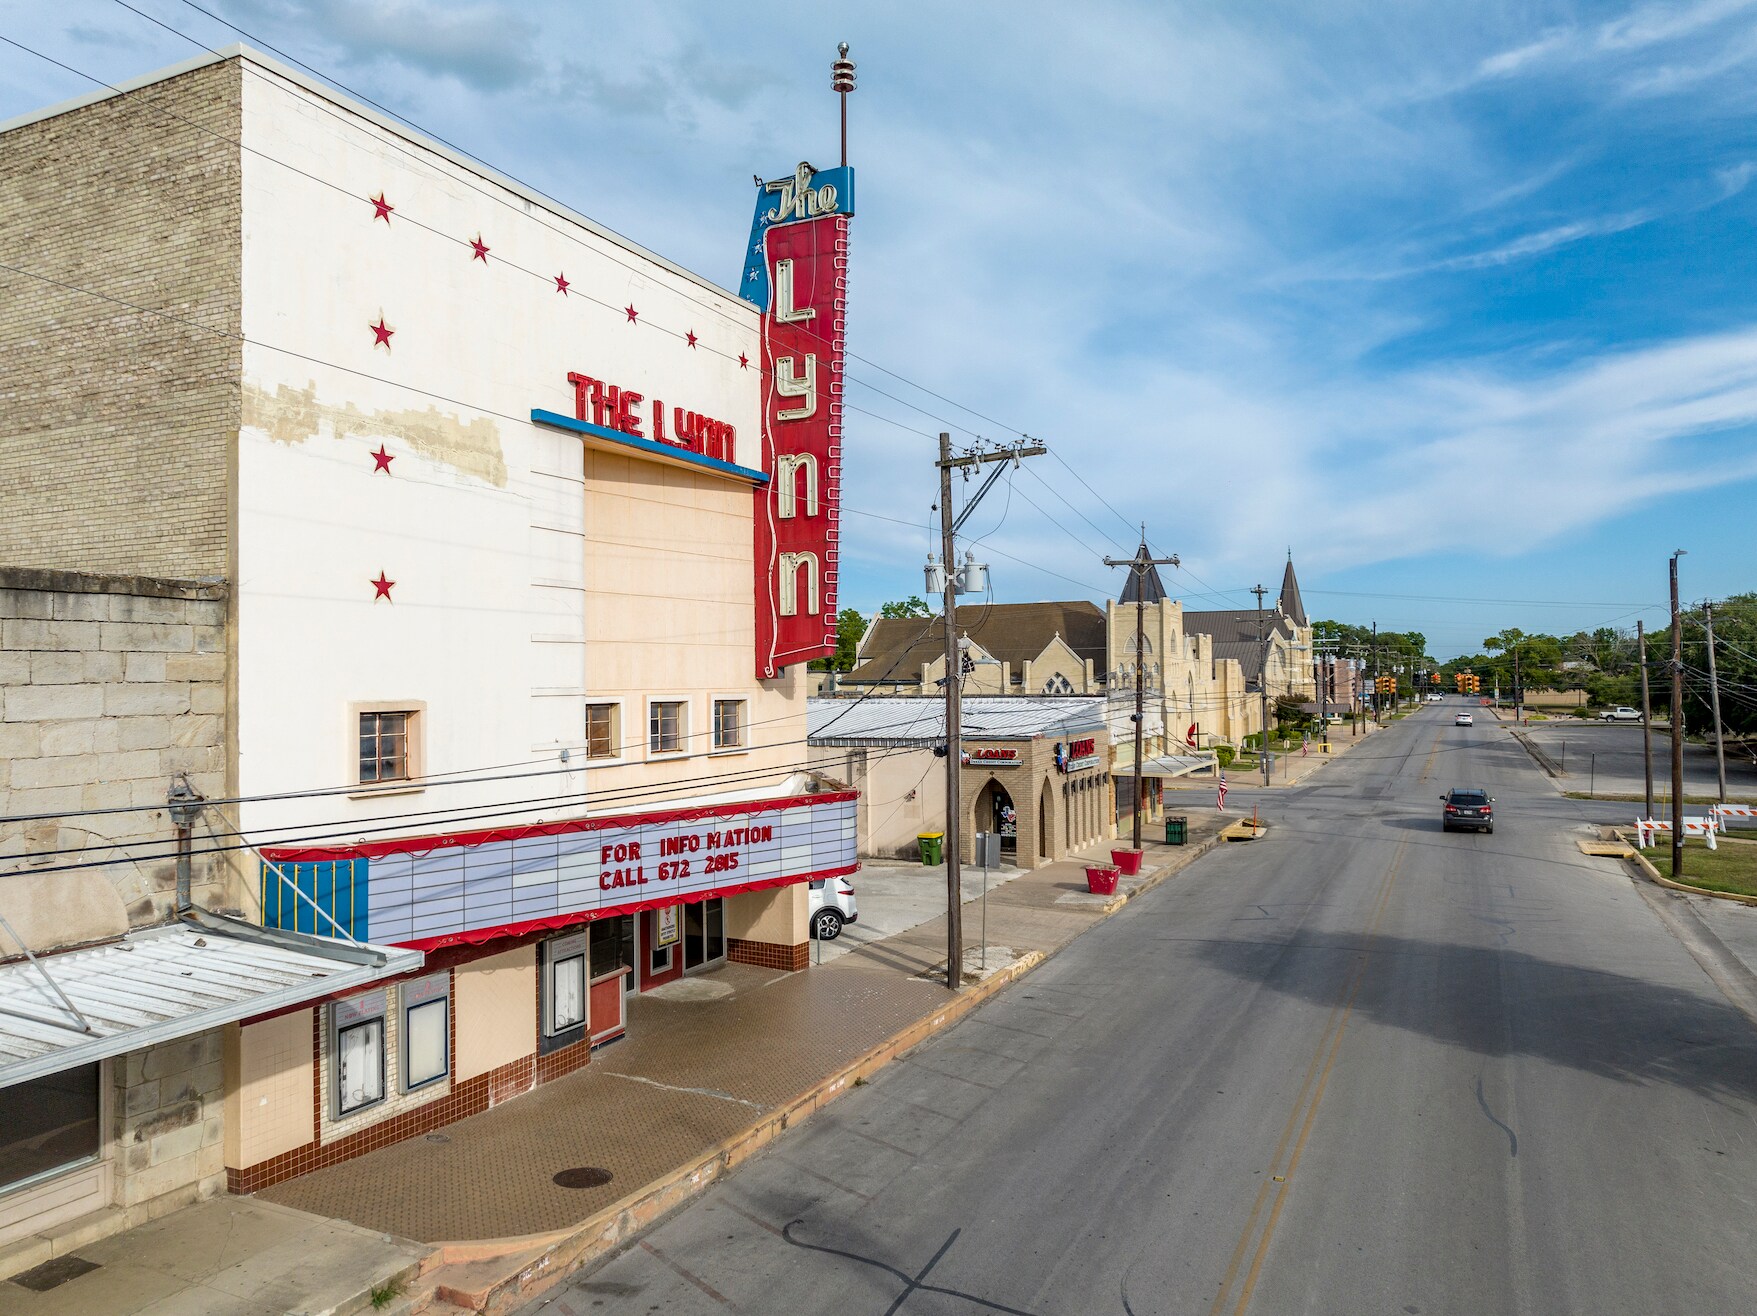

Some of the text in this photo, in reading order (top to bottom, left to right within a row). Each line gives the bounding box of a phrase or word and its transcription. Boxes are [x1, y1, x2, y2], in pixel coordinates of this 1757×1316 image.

[765, 161, 839, 223] The
[567, 371, 645, 438] THE
[976, 748, 1018, 759] LOANS
[1071, 738, 1095, 758] LOANS
[601, 841, 641, 865] FOR
[660, 834, 700, 857] INFO
[599, 851, 739, 890] CALL 672 2815
